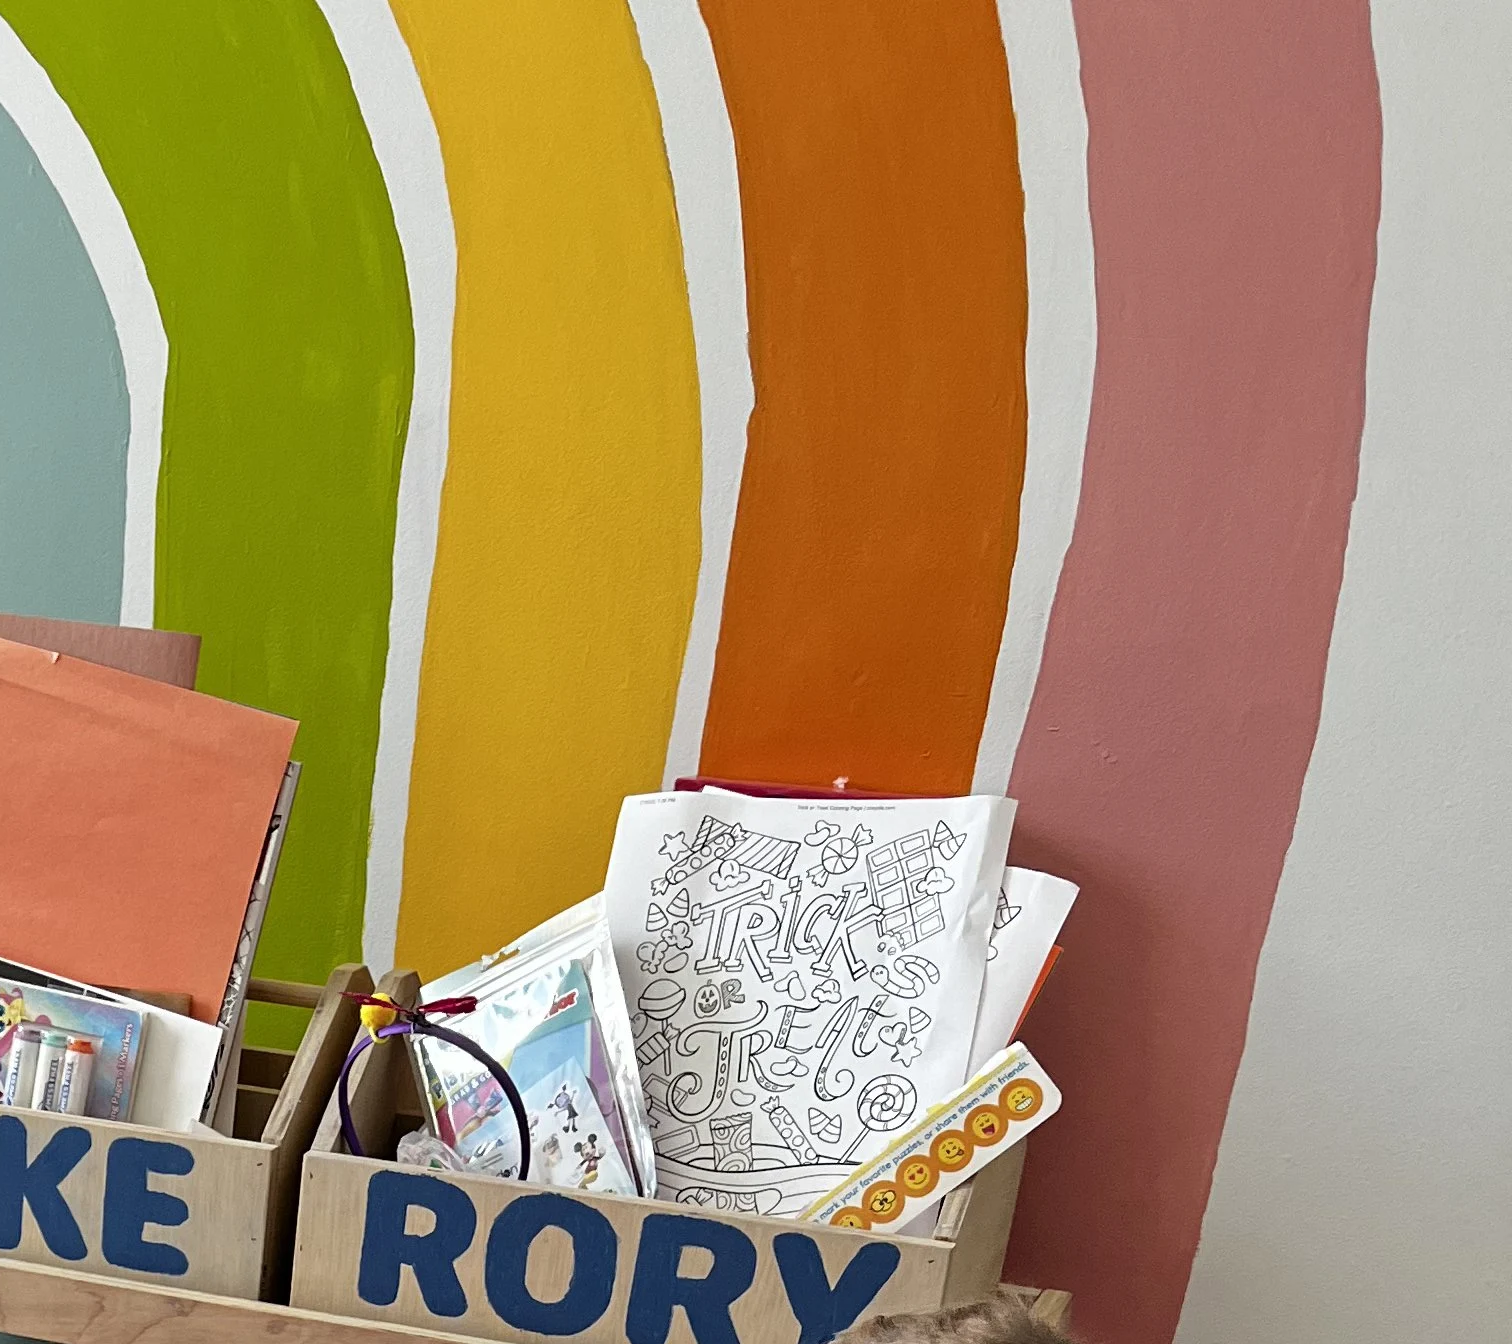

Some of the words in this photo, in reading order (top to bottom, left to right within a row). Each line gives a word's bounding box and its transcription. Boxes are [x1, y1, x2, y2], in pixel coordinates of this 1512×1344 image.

[117, 1023, 135, 1063] Markers
[819, 1202, 841, 1220] mark
[840, 1186, 859, 1206] your
[859, 1161, 892, 1188] favorite
[892, 1138, 925, 1167] puzzles,
[924, 1130, 933, 1140] or
[935, 1112, 958, 1133] share
[958, 1097, 981, 1115] them
[980, 1083, 999, 1098] with
